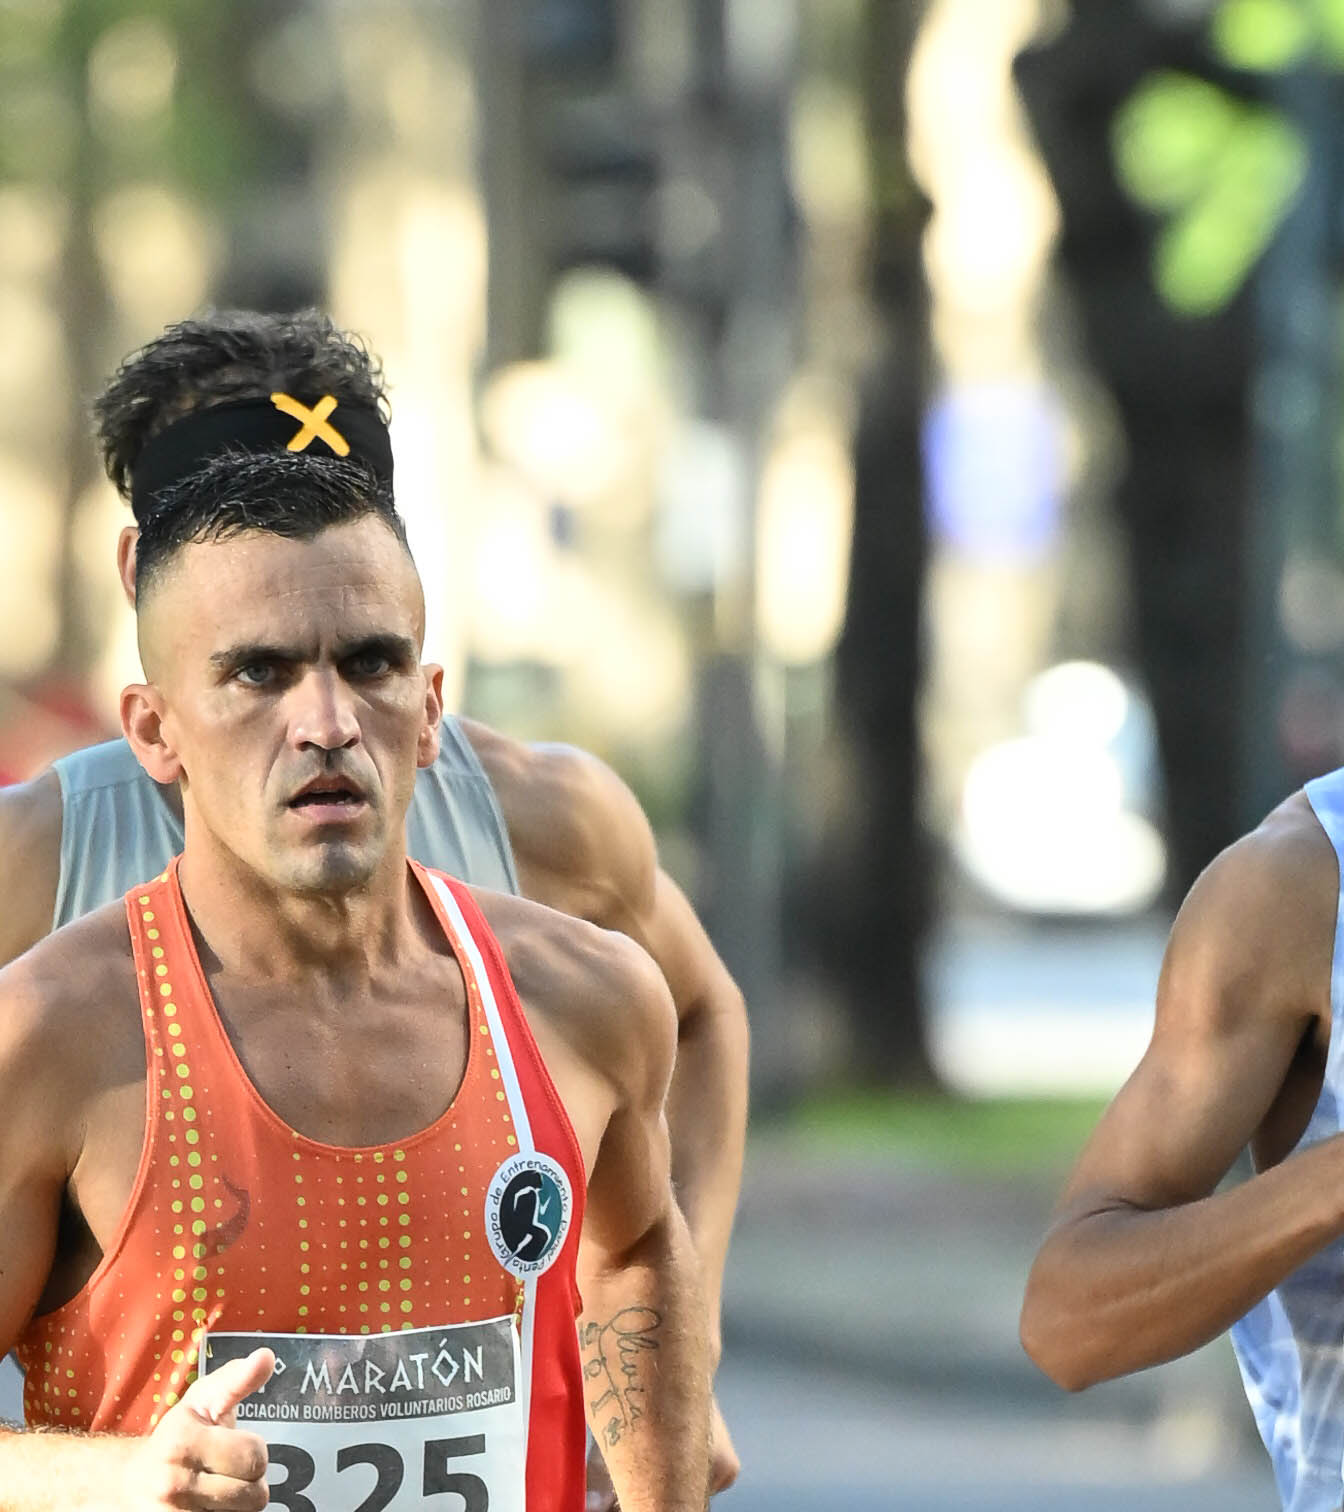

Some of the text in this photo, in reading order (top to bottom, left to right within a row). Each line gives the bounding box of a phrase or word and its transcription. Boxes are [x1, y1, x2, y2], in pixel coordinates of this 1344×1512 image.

[492, 1187, 502, 1205] de
[490, 1212, 513, 1262] Grupo
[300, 1338, 484, 1395] MARATÓN
[237, 1386, 512, 1421] OCIACIÓN BOMBEROS VOLUNTARIOS ROSARIO
